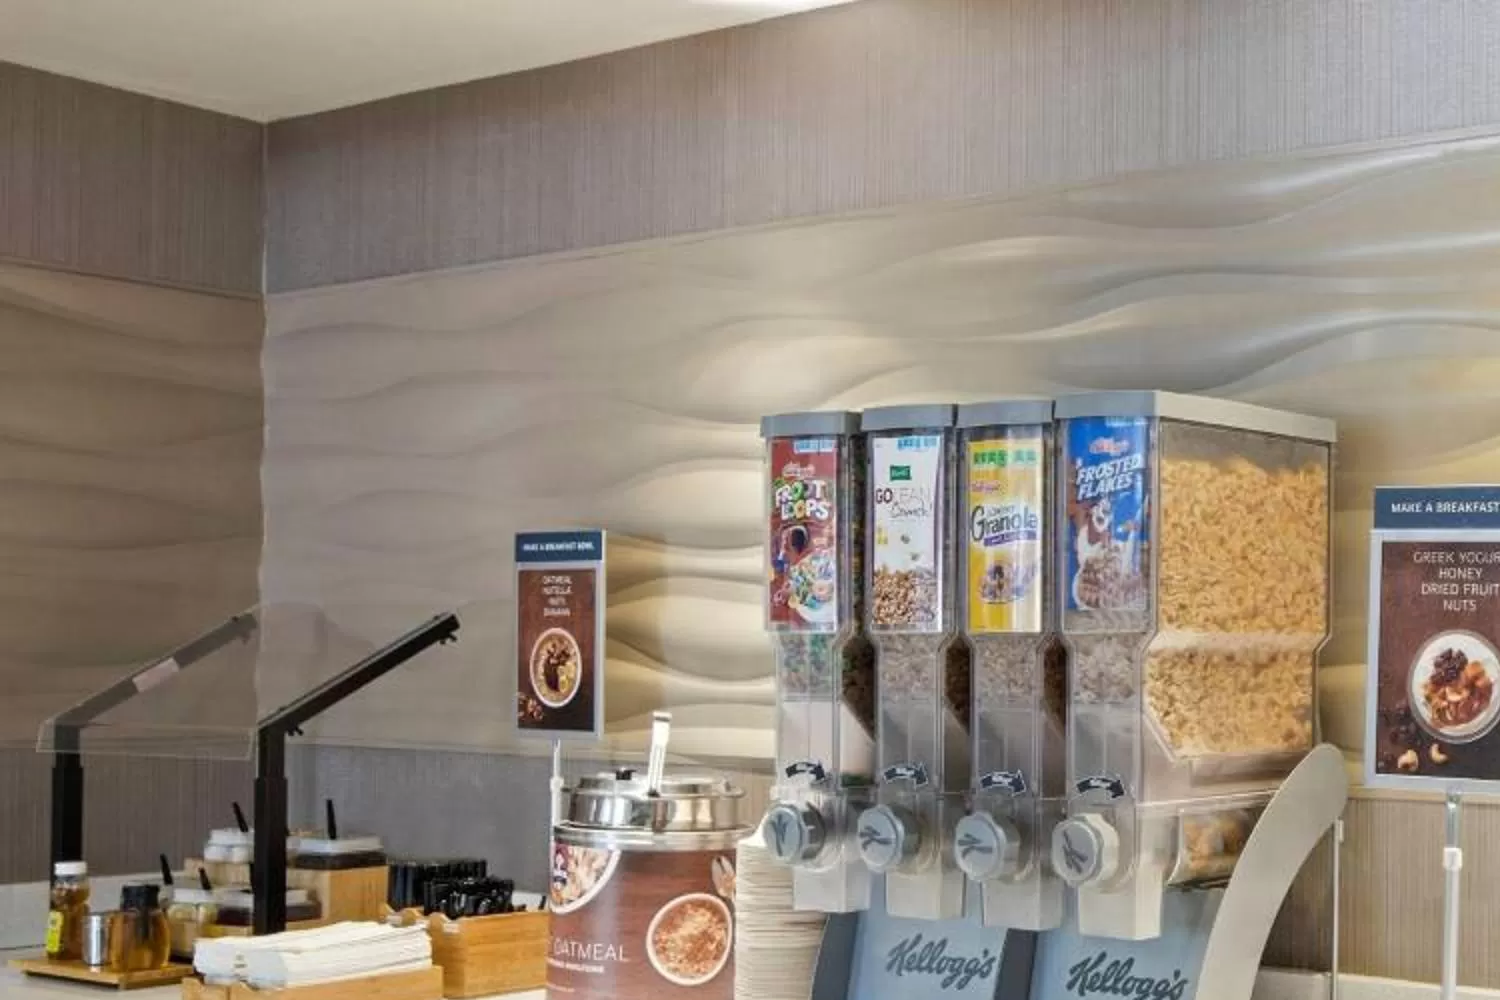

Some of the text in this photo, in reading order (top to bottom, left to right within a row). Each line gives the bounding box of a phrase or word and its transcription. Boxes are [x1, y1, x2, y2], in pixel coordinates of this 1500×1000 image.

[1076, 453, 1142, 484] FROSTED
[1077, 473, 1134, 500] FLAKES
[1391, 502, 1422, 513] MAKE
[1425, 502, 1433, 513] A
[1436, 502, 1500, 513] BREAKFAST
[971, 505, 1038, 541] Granola
[1413, 551, 1455, 564] GREEK
[1438, 567, 1483, 579] HONEY
[1421, 583, 1500, 595] DRIED FRUIT
[1443, 599, 1477, 612] NUTS
[886, 934, 997, 990] Kellogg's
